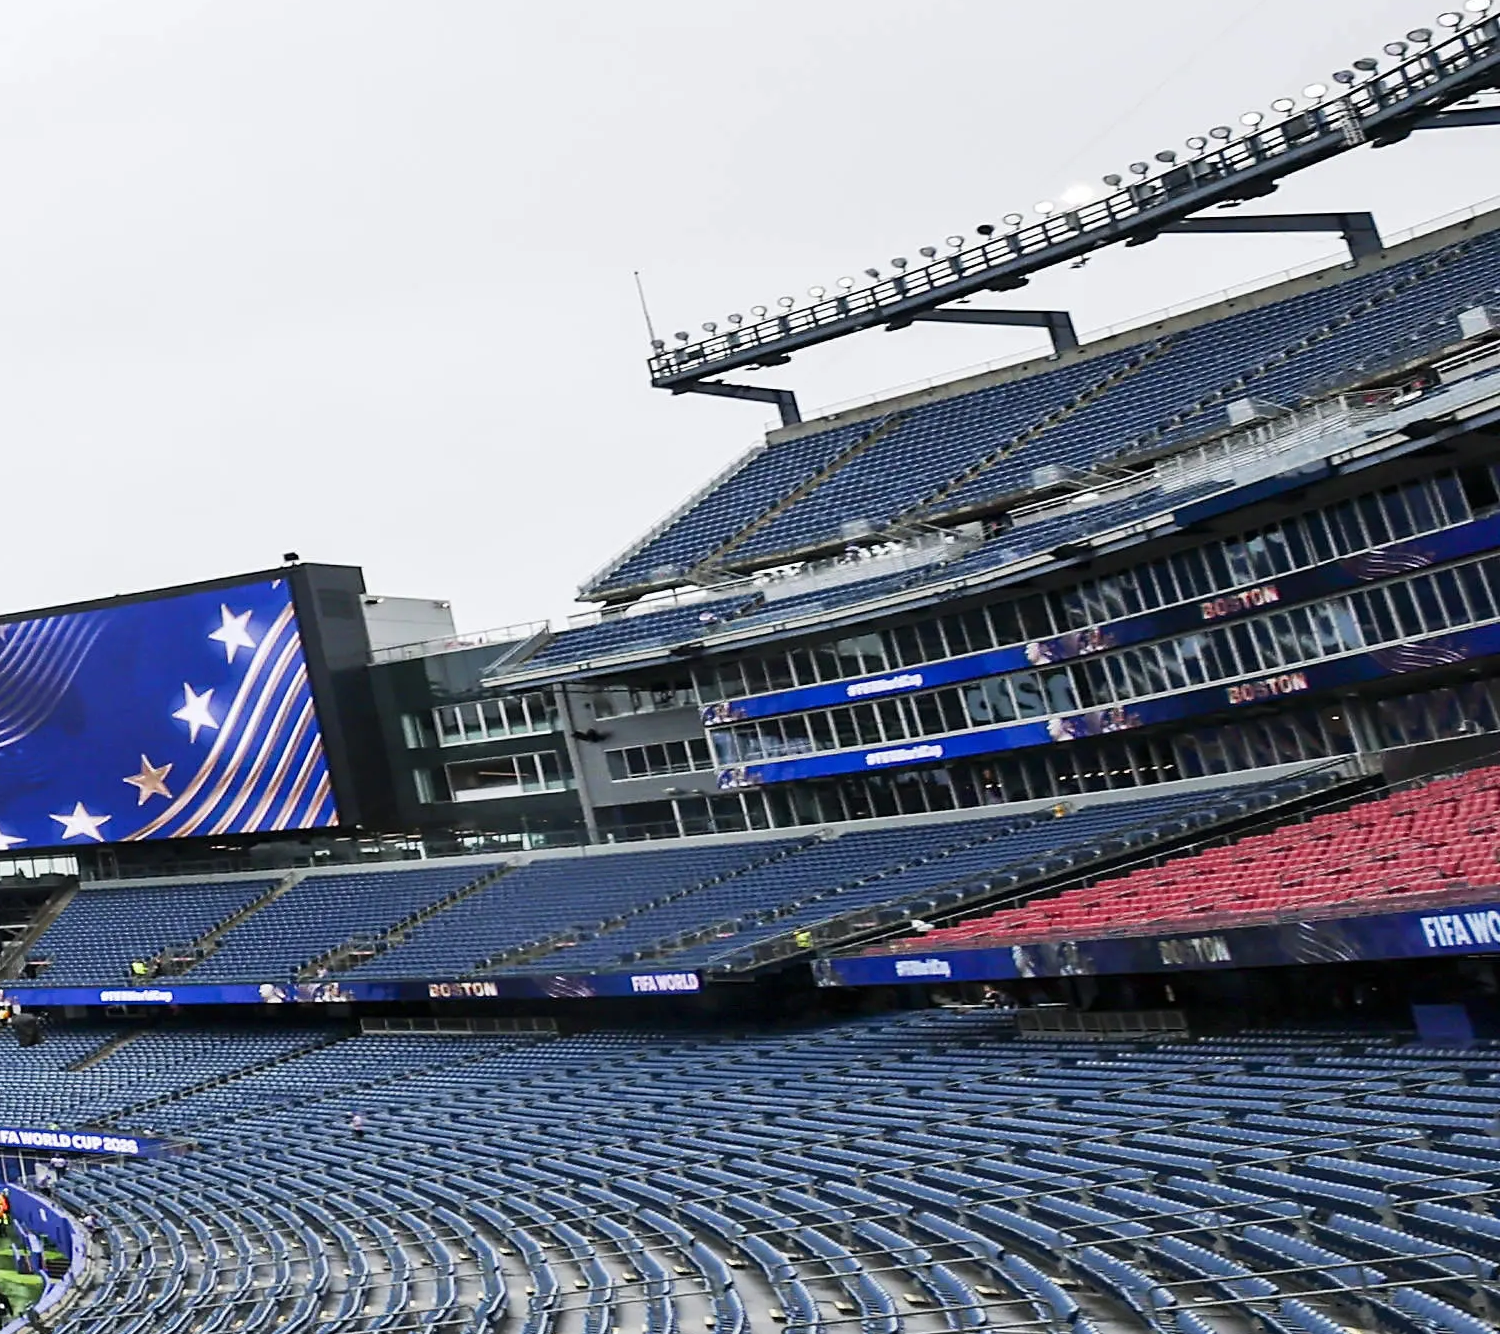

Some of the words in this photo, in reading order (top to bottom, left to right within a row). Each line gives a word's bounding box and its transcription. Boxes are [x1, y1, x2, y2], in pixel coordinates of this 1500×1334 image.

[1420, 914, 1473, 947] FIFA
[429, 982, 498, 997] BOSTON
[631, 976, 657, 992] FIFA
[656, 973, 699, 991] WORLD
[19, 1131, 70, 1148] WORLD
[71, 1135, 102, 1150] CUP
[102, 1137, 139, 1154] 2026
